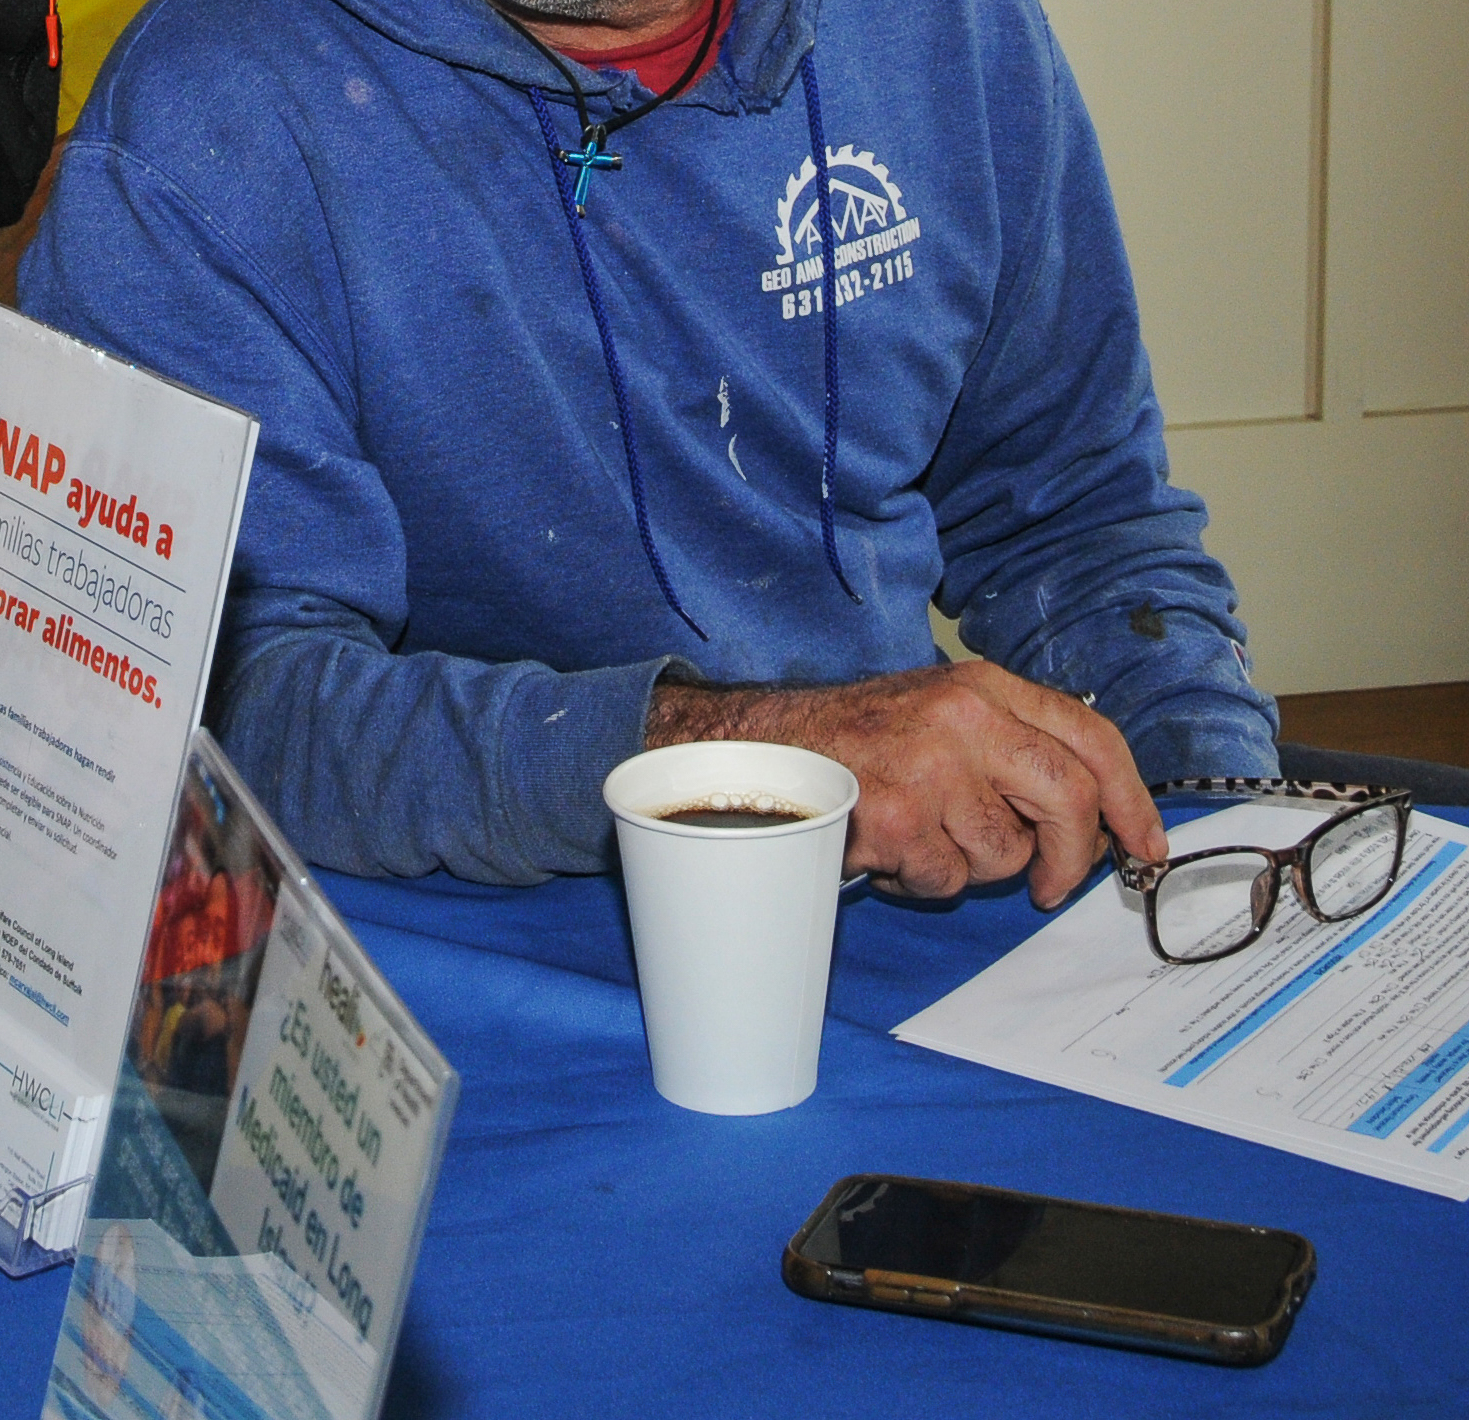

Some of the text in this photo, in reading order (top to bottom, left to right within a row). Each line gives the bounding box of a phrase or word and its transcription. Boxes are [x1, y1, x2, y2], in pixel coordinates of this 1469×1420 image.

[762, 267, 792, 292] GEO
[834, 216, 921, 270] CONSTRUCTION
[66, 477, 150, 548] ayuda
[155, 523, 174, 560] a
[47, 540, 175, 639] trabajadoras
[41, 613, 162, 709] alimentos.
[7, 706, 32, 732] familias
[32, 723, 74, 758] trabajadoras
[73, 747, 95, 771] hagan
[94, 764, 116, 783] rendir
[11, 1065, 65, 1123] HWCLI
[312, 1042, 360, 1129] usted
[358, 1110, 380, 1168] un
[270, 1063, 364, 1229] miembro de
[236, 1085, 373, 1340] Medicaid en Long
